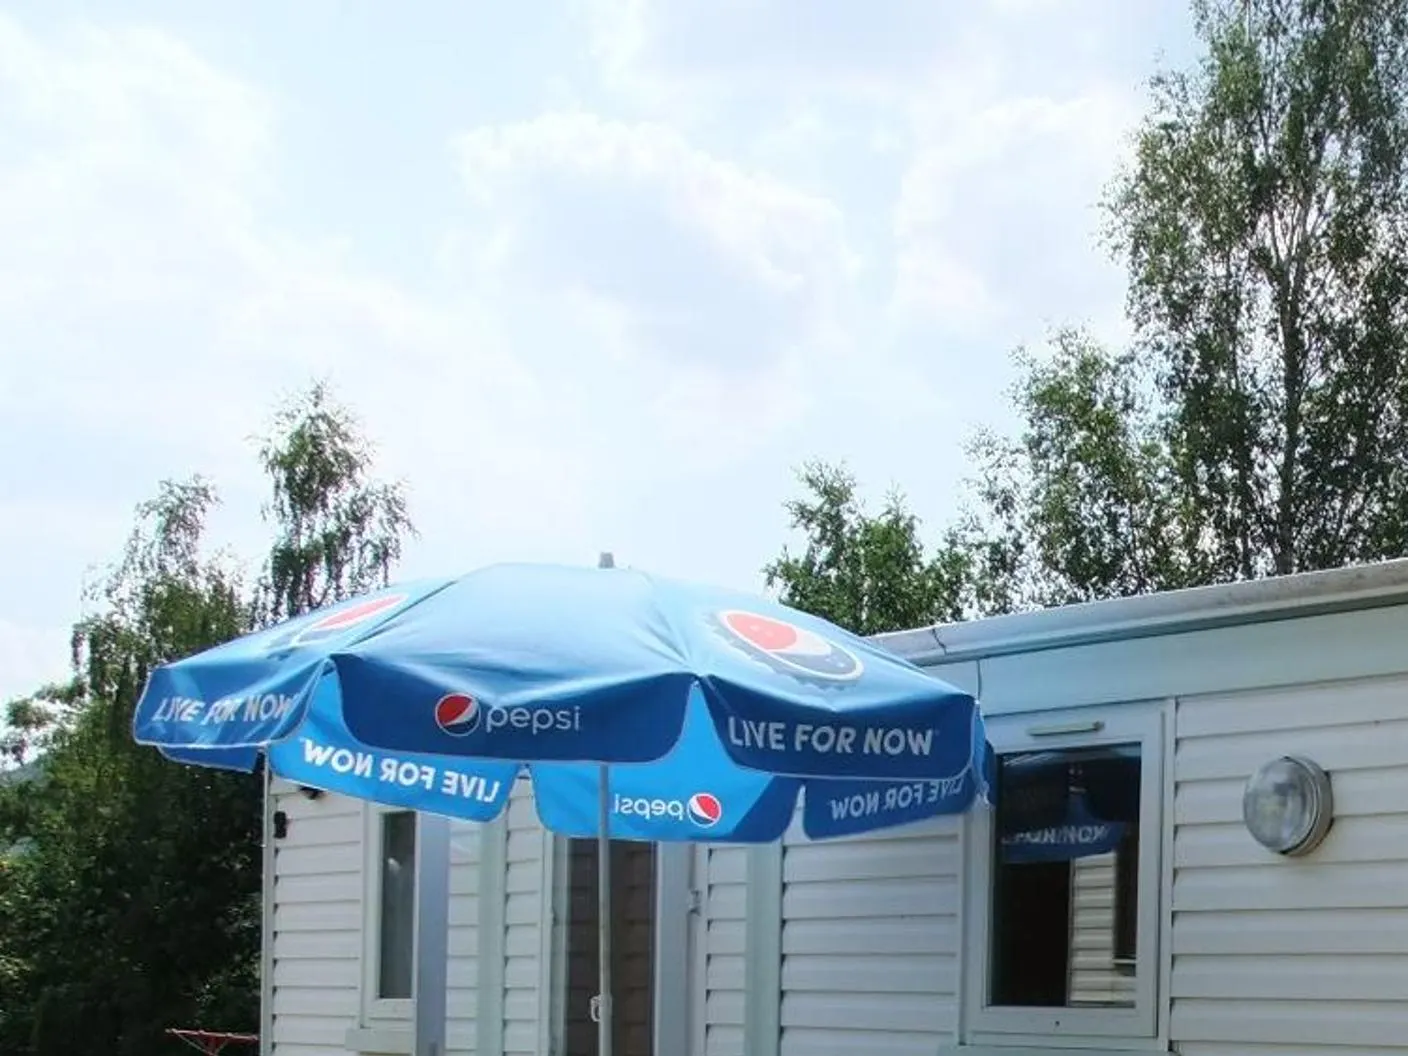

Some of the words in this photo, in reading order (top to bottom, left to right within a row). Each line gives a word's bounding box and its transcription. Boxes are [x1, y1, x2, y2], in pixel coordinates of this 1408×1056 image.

[152, 696, 205, 722] LIVE
[243, 692, 302, 722] NOW
[486, 705, 581, 735] pepsi
[728, 716, 786, 750] LIVE
[794, 724, 857, 754] FOR
[863, 728, 934, 755] NOW
